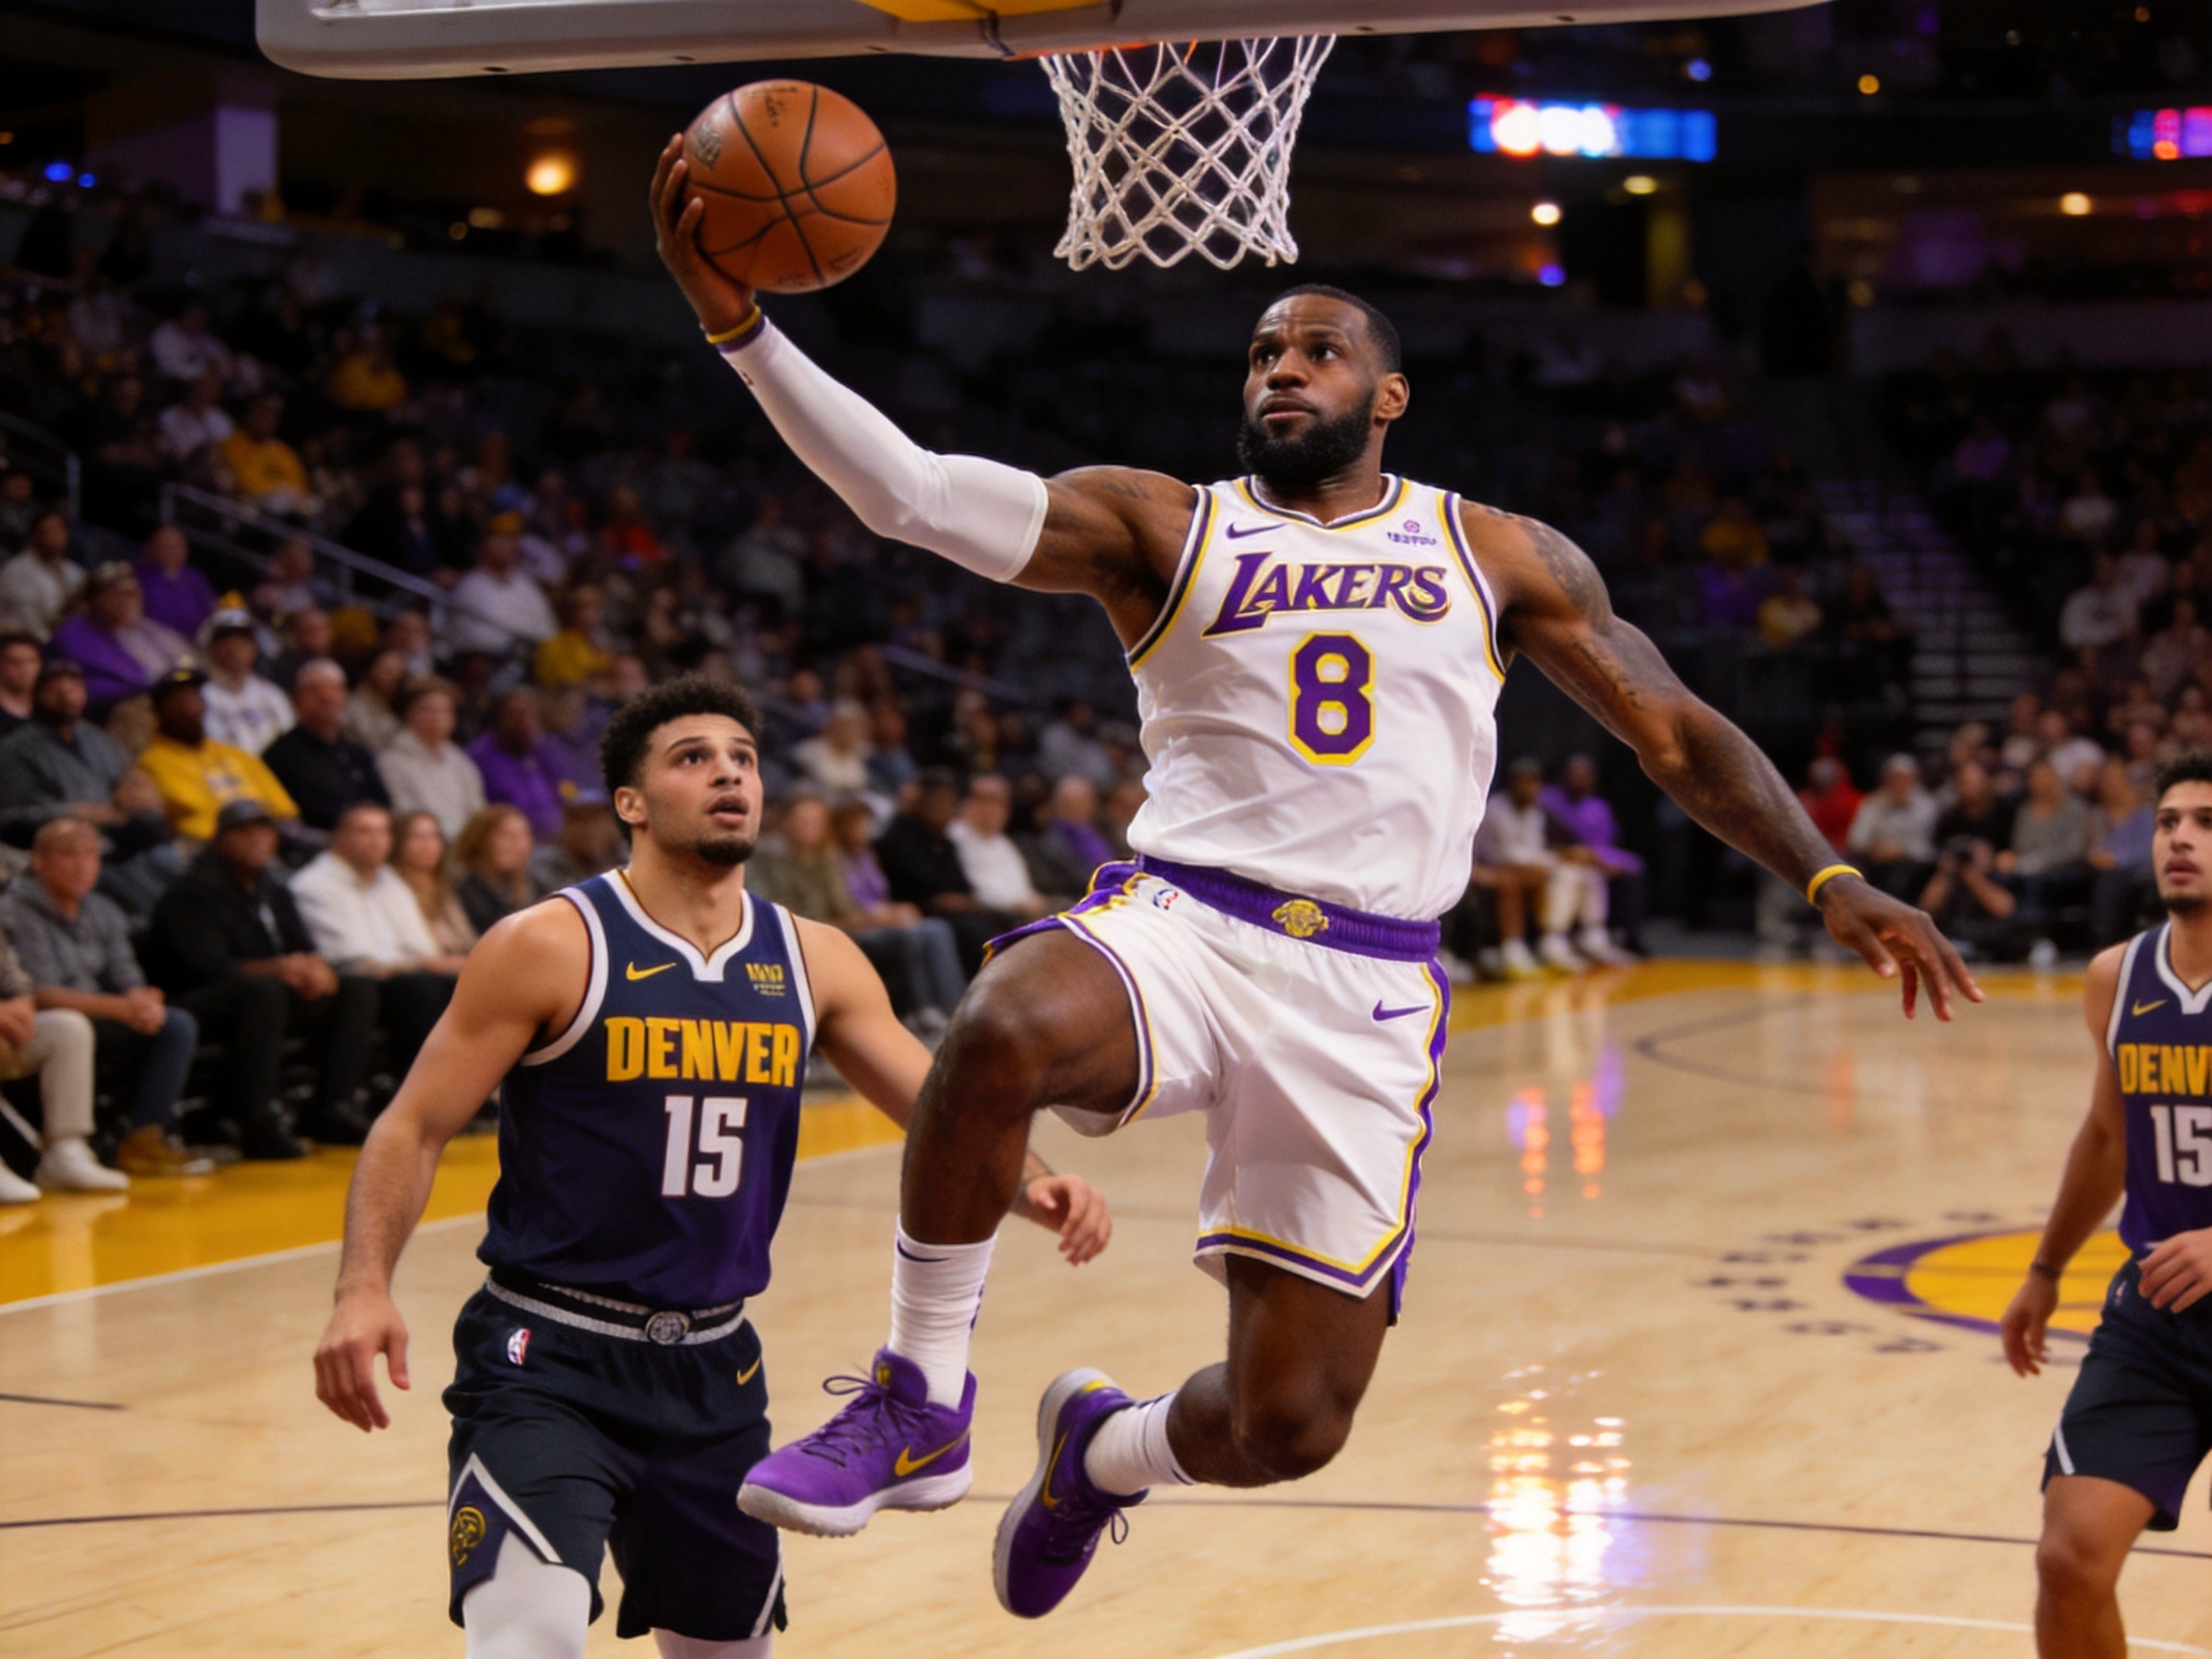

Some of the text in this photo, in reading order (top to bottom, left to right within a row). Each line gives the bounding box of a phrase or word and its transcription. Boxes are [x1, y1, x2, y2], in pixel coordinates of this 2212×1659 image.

[1200, 551, 1452, 640] LAKERS
[1288, 630, 1376, 766] 8
[604, 1016, 801, 1088] DENVER
[2117, 1043, 2212, 1095] DENV
[661, 1094, 748, 1197] 15
[2150, 1104, 2212, 1187] 15
